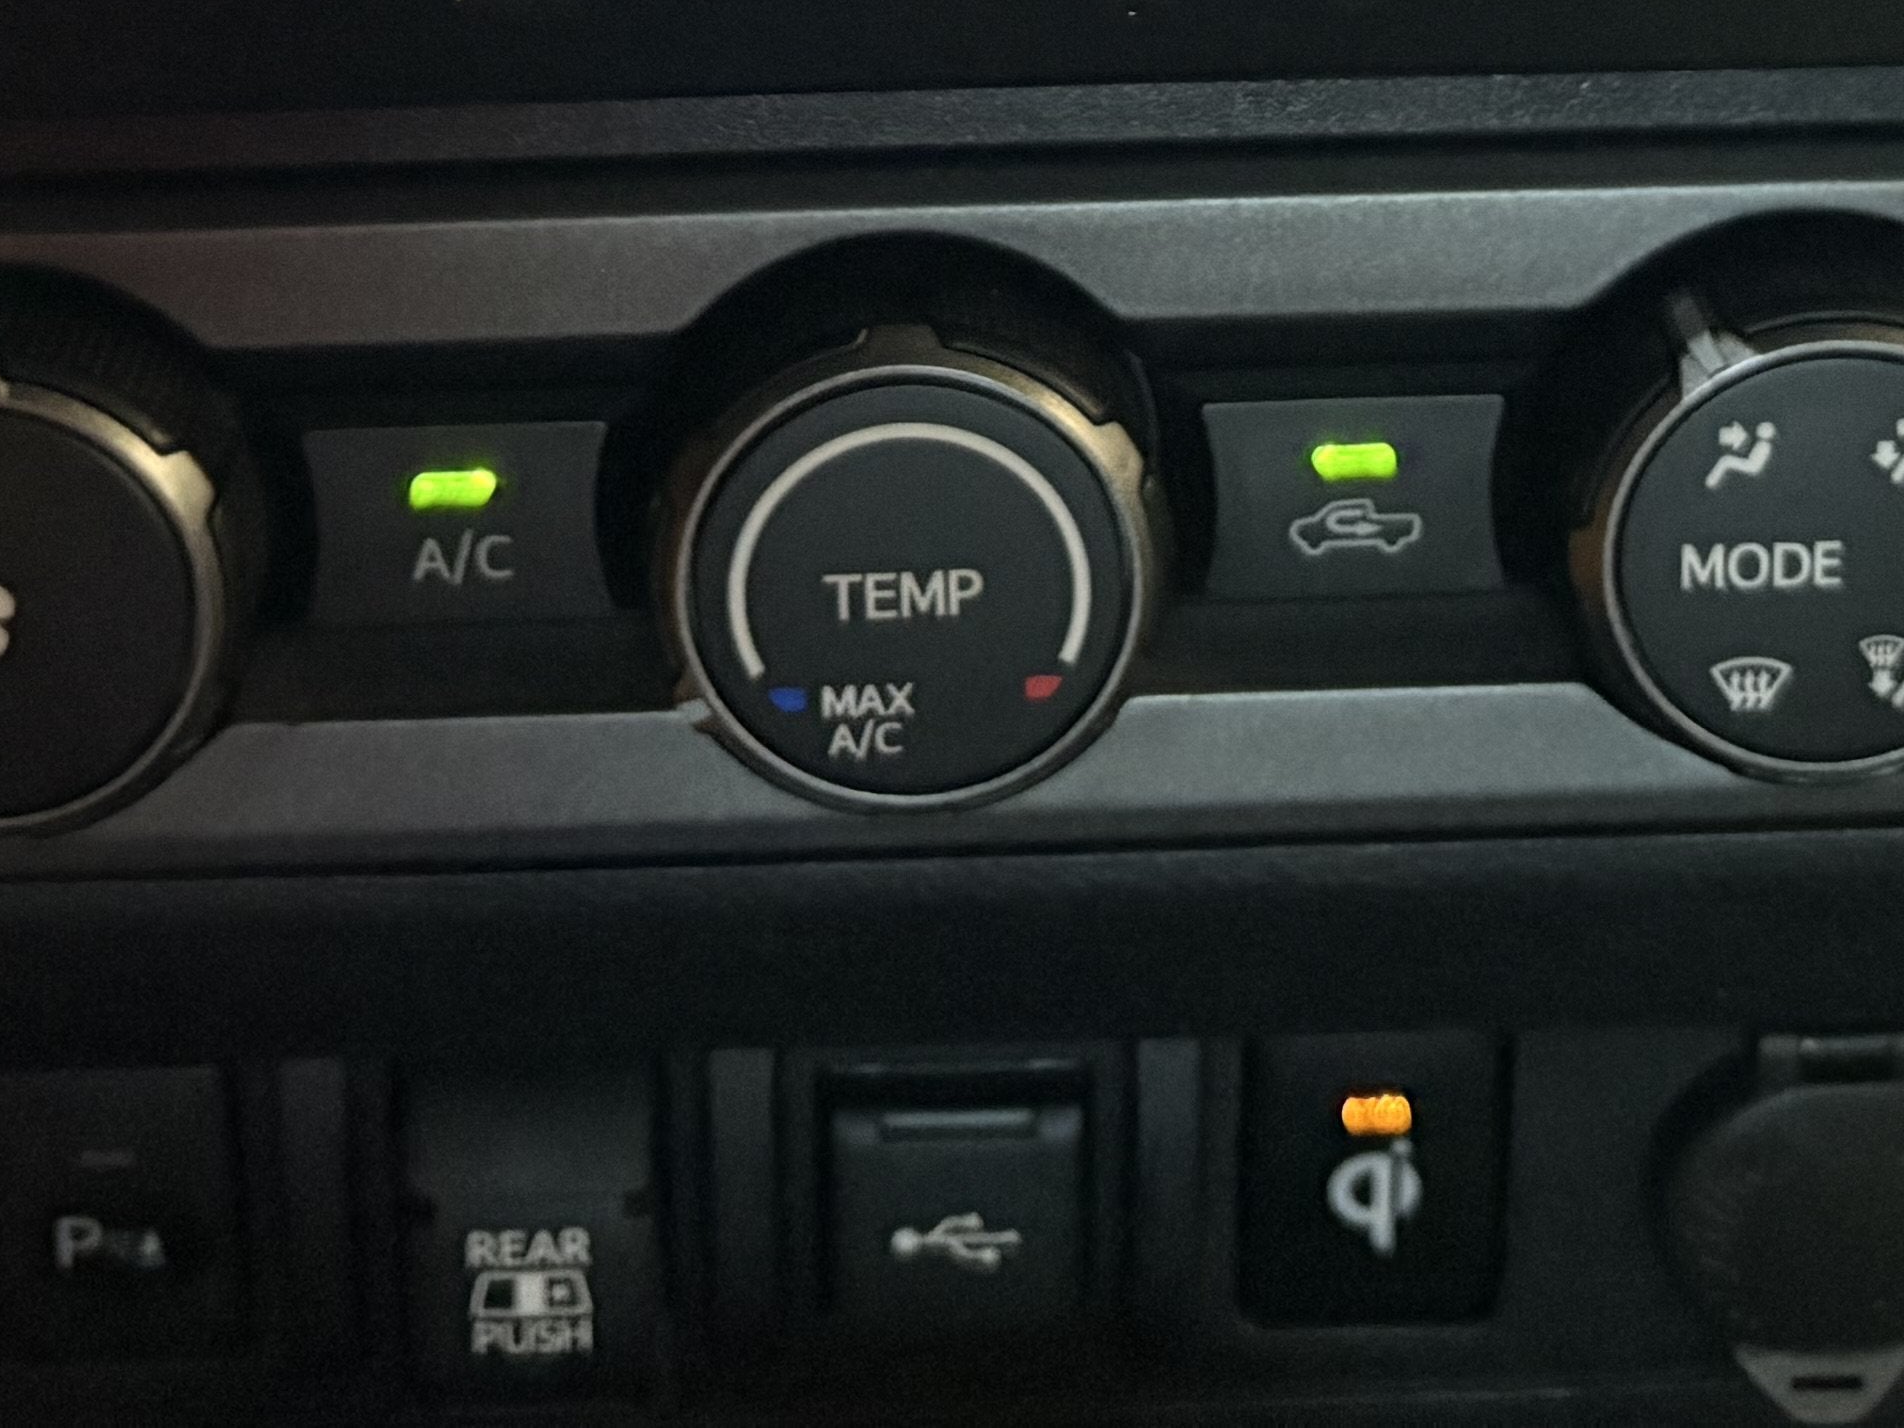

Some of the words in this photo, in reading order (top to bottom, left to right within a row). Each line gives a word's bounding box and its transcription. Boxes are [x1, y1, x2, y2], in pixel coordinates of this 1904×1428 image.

[413, 529, 514, 586] A/C
[1680, 540, 1844, 590] MODE
[821, 569, 984, 622] TEMP
[820, 681, 915, 720] MAX
[827, 720, 904, 761] A/C
[466, 1226, 591, 1268] REAR
[471, 1318, 593, 1354] PUSH
